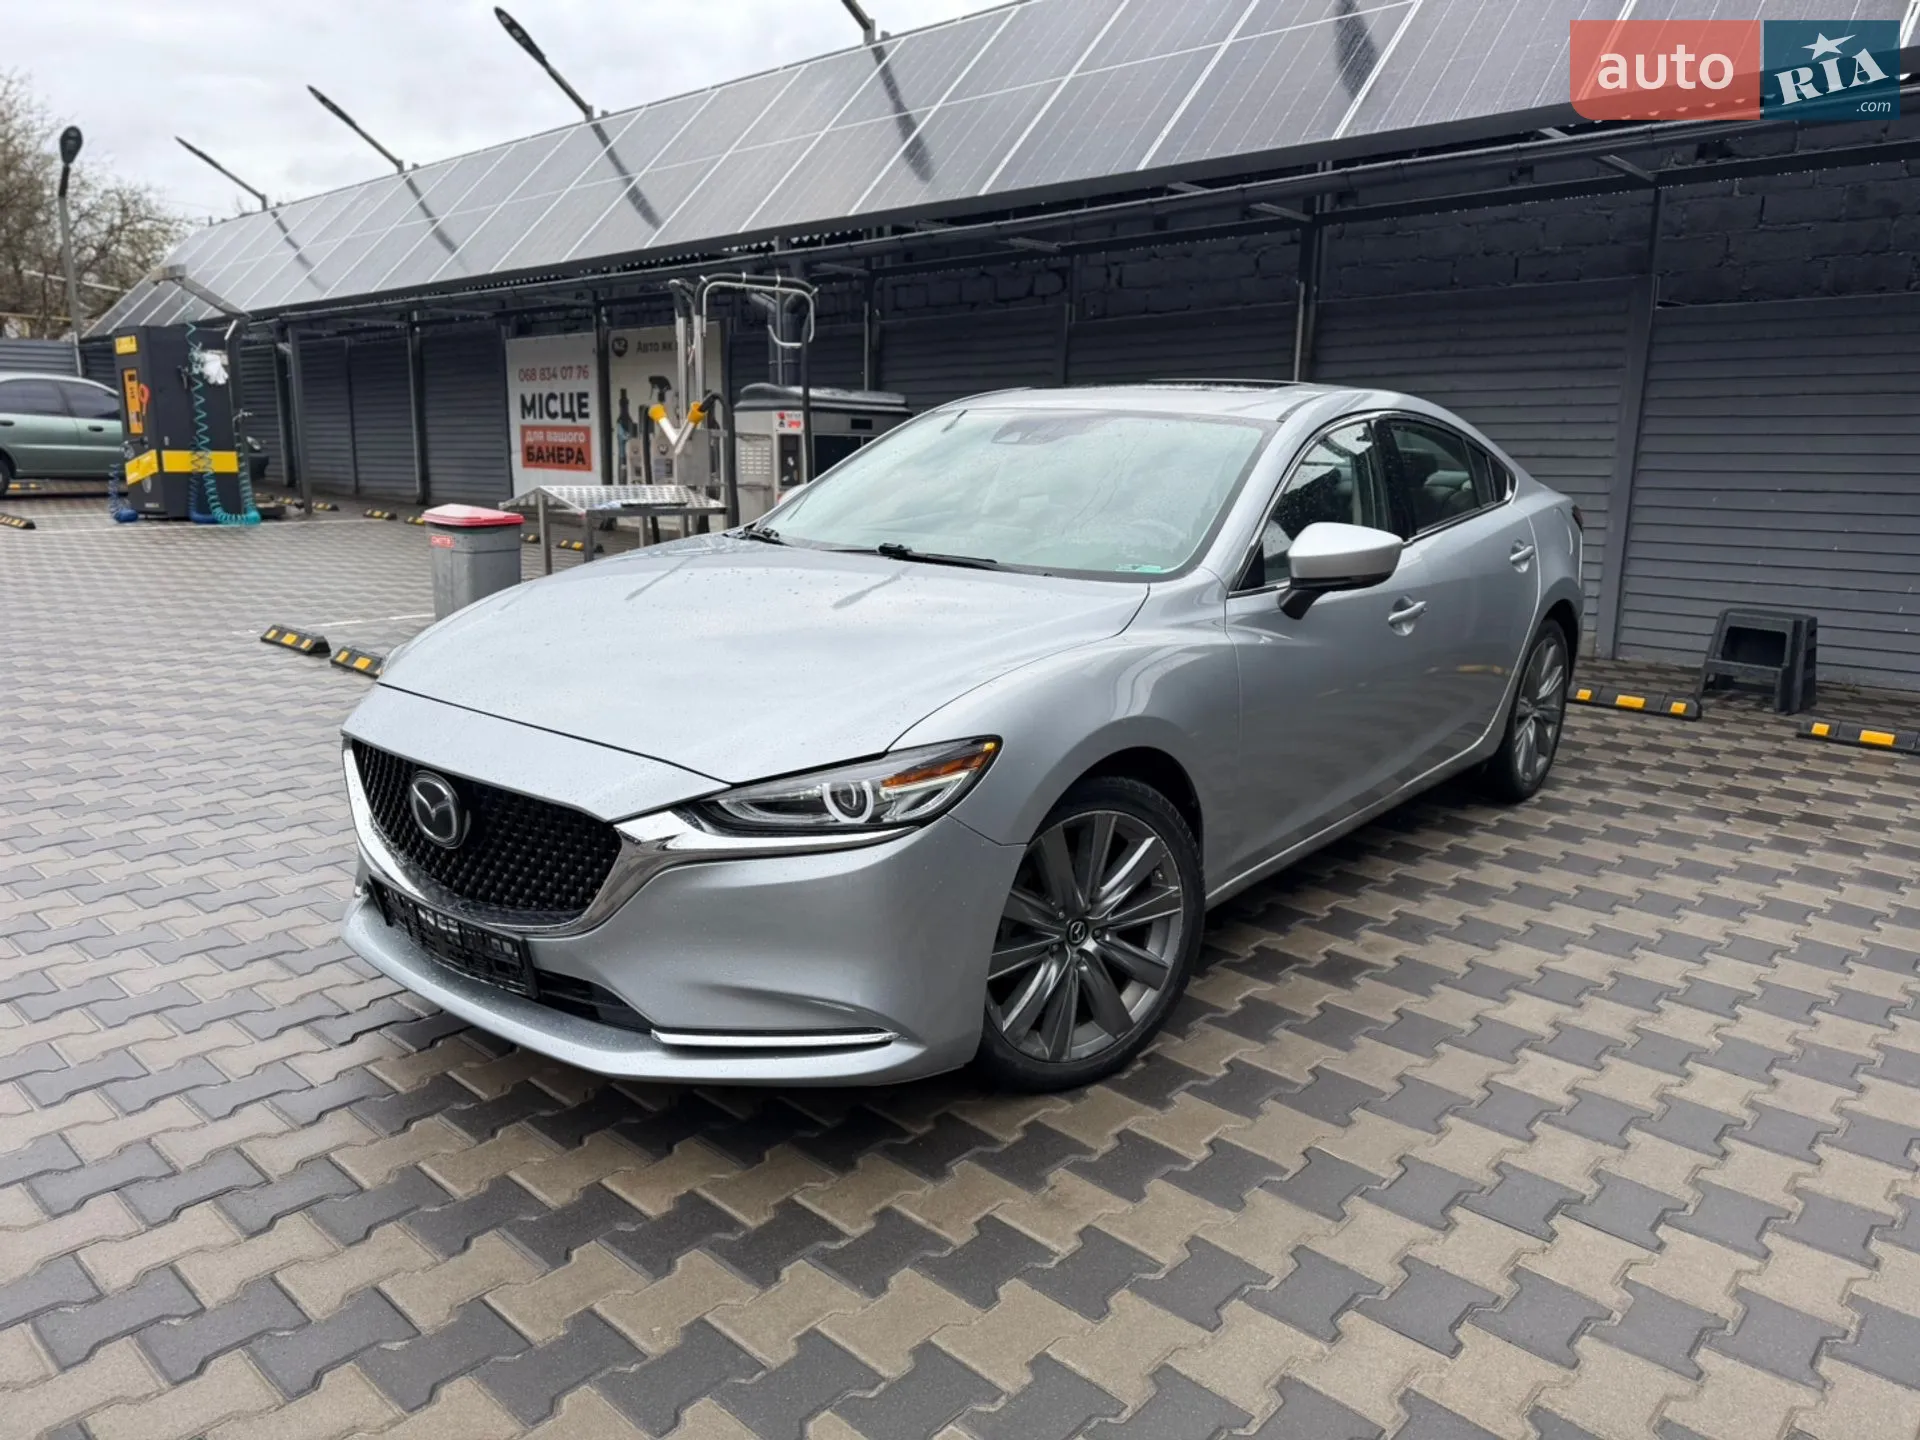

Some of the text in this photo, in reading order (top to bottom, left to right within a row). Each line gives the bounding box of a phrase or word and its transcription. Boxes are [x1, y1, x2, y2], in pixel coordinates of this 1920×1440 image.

[636, 341, 660, 354] Авто
[518, 364, 590, 382] 068 834 07 76
[520, 391, 590, 423] МІСЦЕ
[526, 446, 587, 465] БАНЕРА
